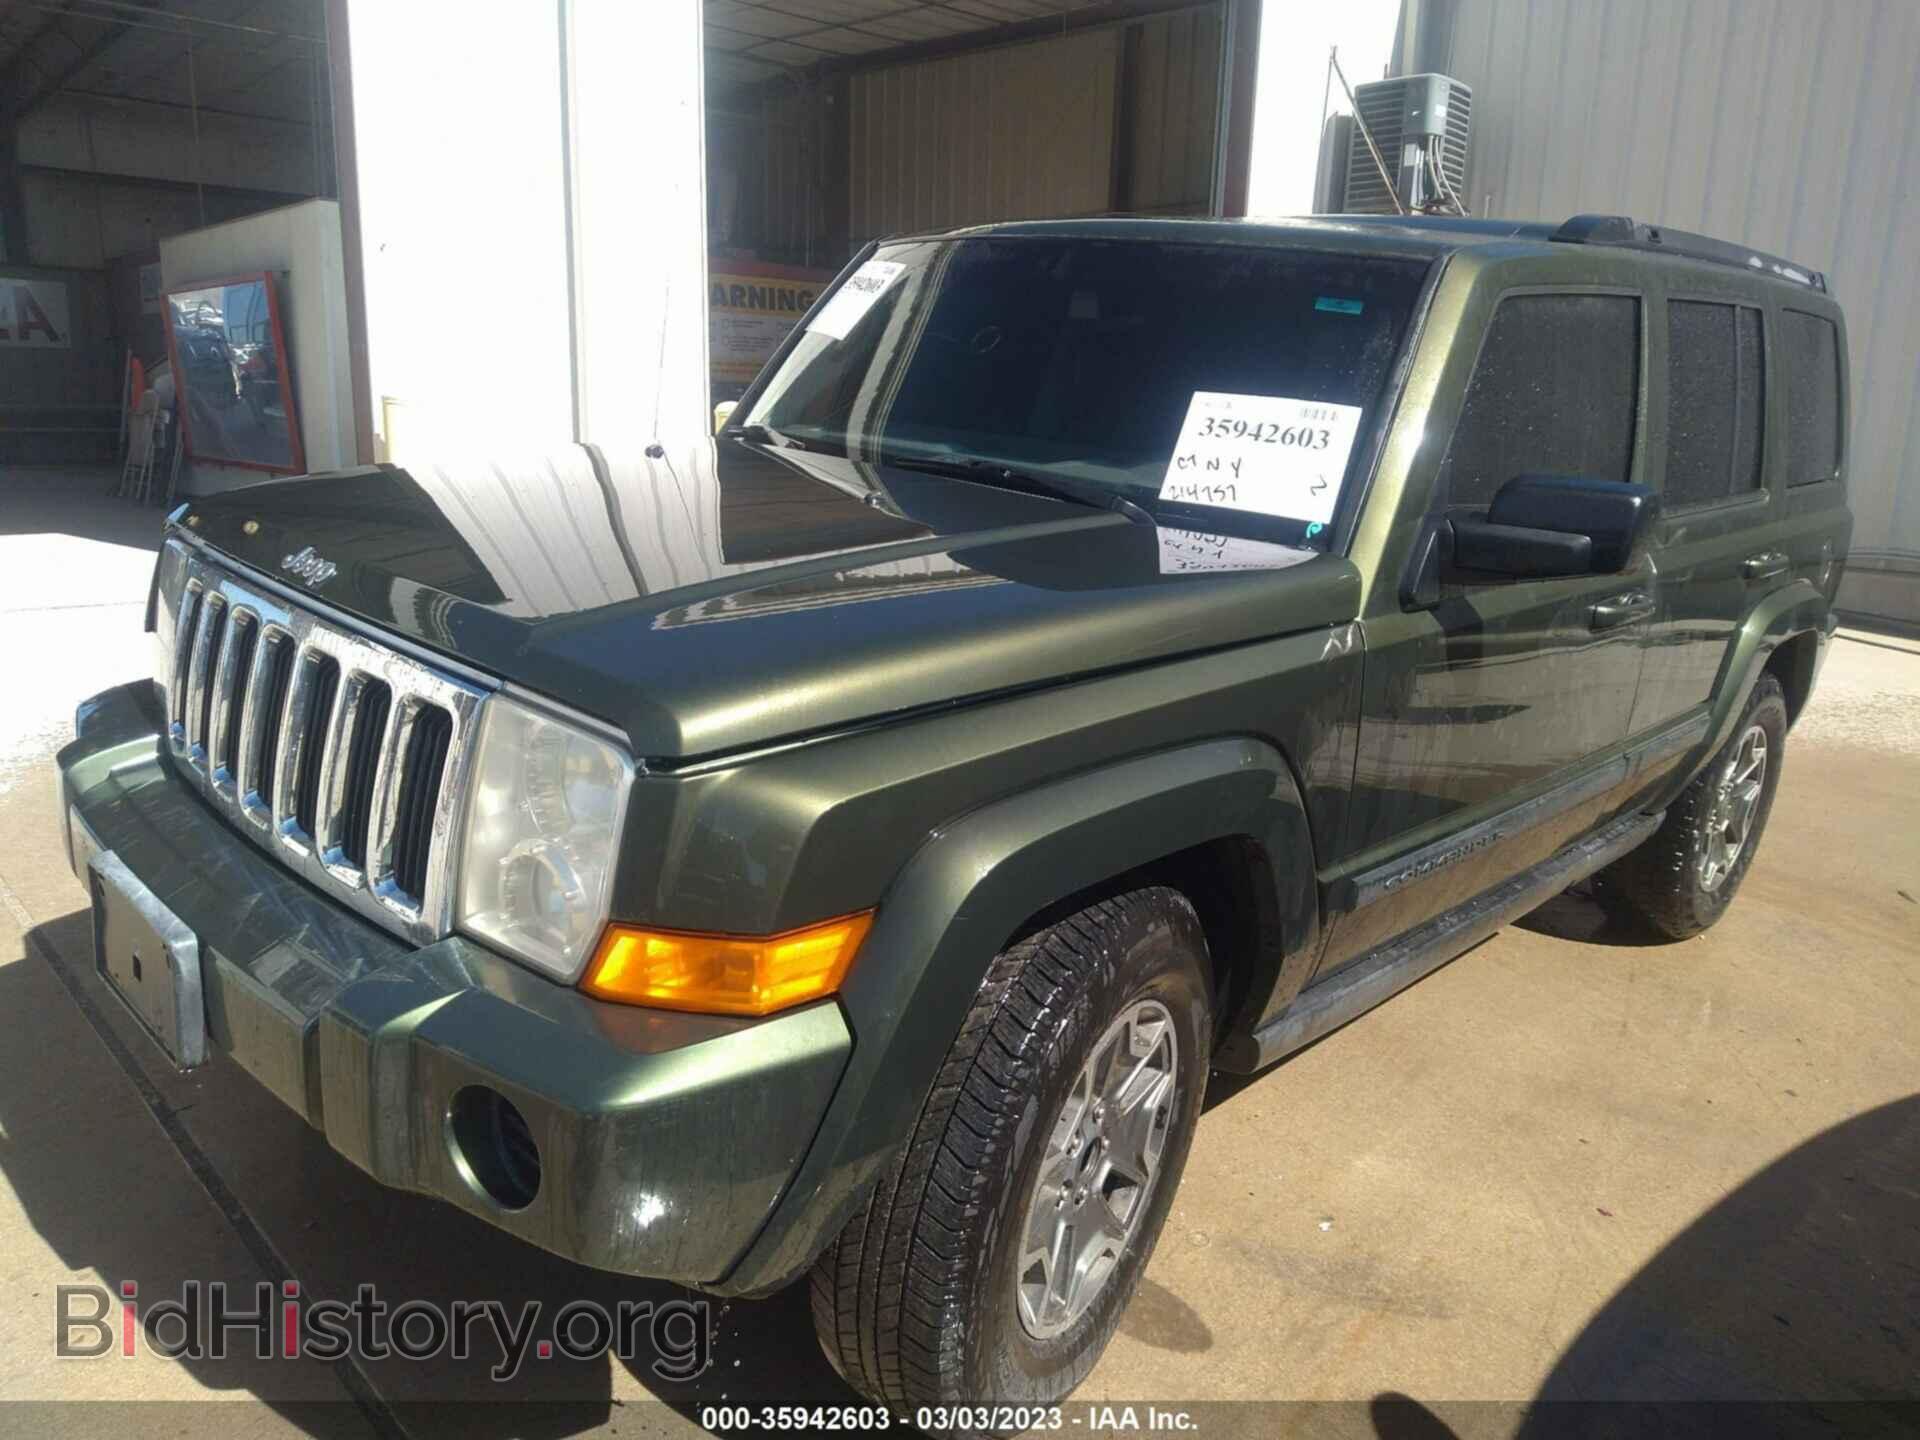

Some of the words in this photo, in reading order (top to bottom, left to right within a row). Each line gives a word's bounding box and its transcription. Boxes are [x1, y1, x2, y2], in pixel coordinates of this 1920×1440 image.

[711, 282, 815, 312] ARNING
[1199, 416, 1331, 450] 35942603
[281, 547, 337, 586] Jeep
